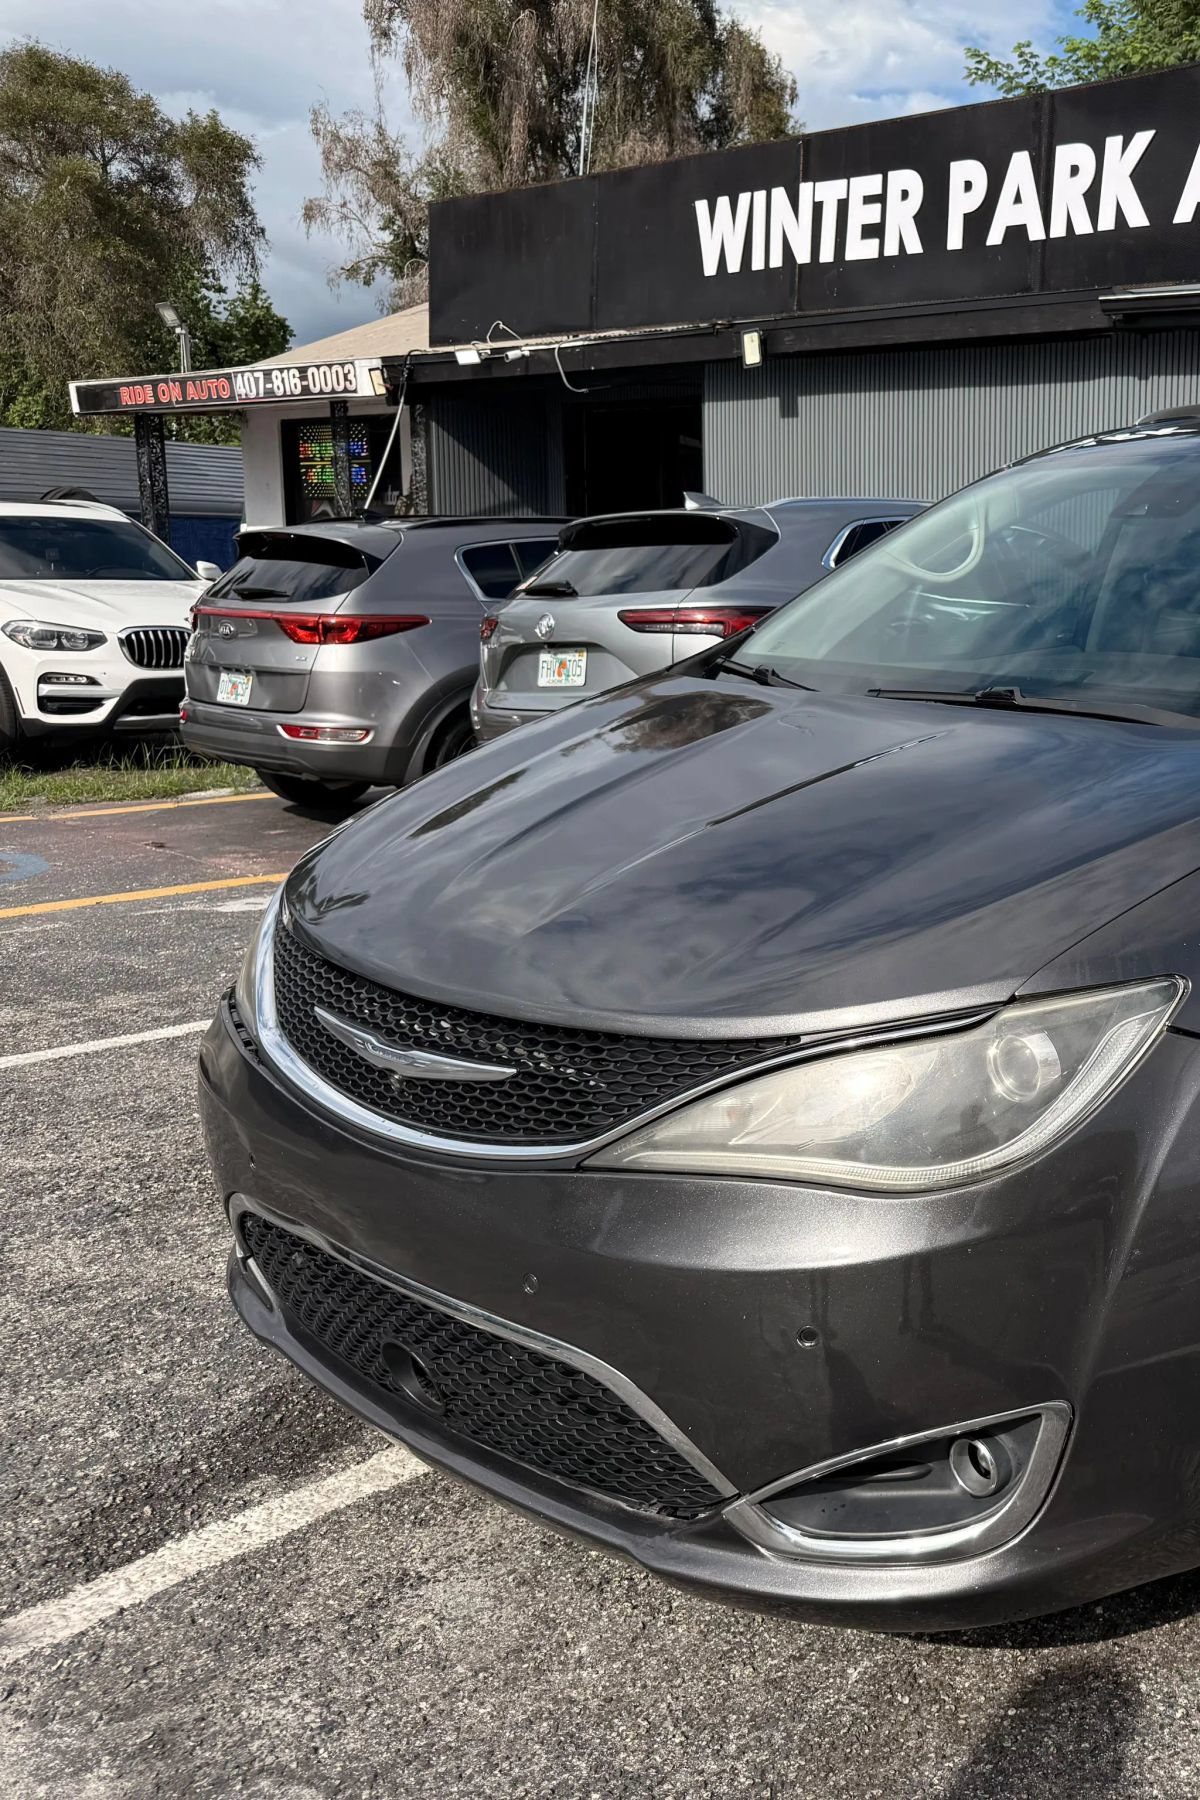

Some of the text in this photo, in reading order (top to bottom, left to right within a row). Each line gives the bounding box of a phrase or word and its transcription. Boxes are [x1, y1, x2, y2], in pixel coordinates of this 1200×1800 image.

[694, 168, 924, 277] WINTER
[946, 129, 1157, 251] PARK
[119, 363, 357, 406] RIDE ON AUTO 407-816-0003
